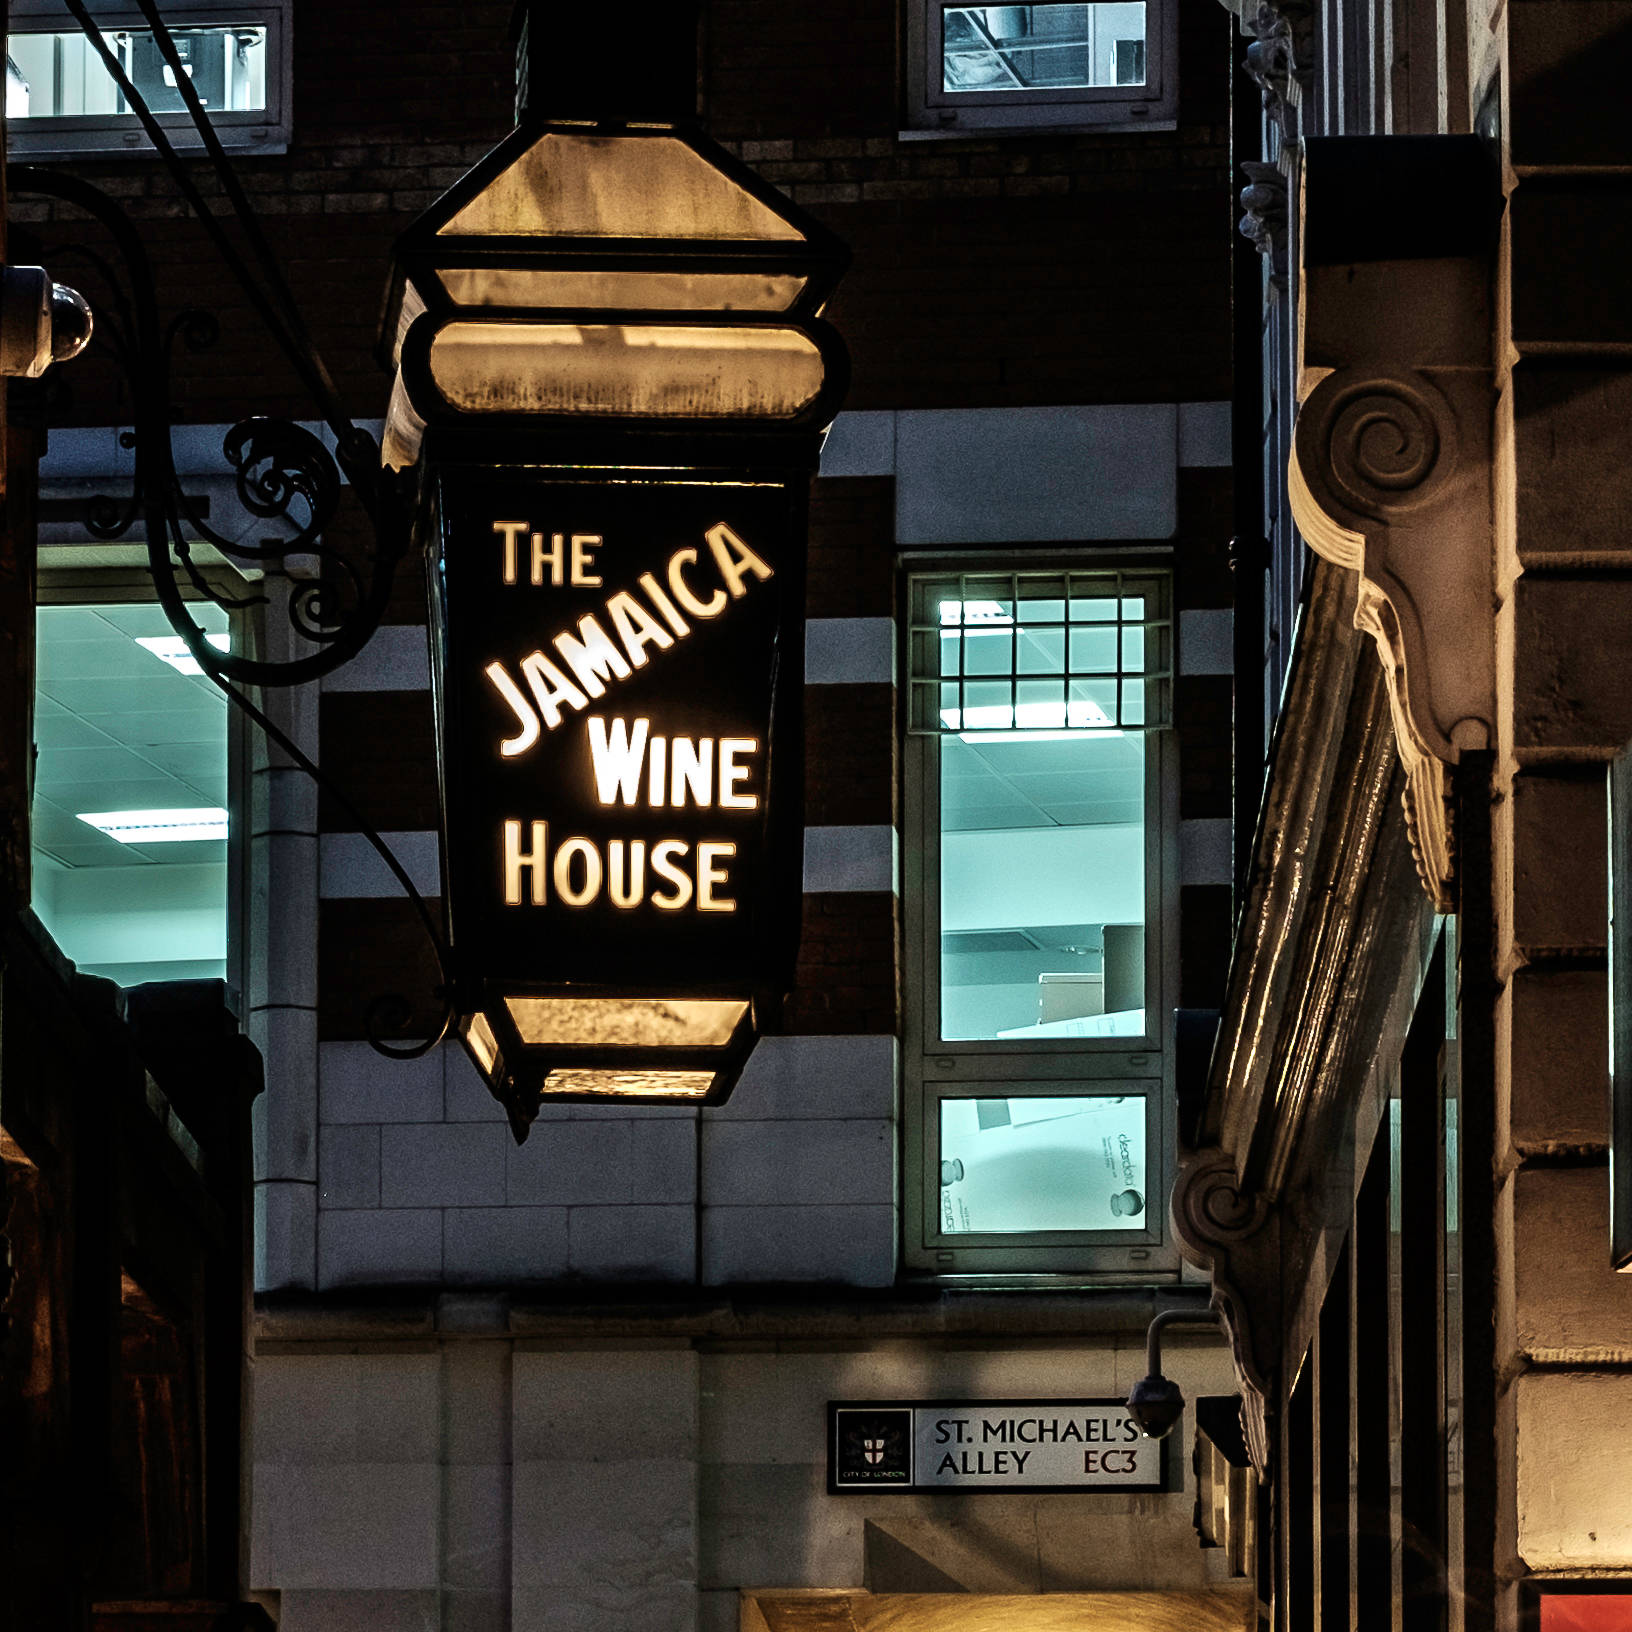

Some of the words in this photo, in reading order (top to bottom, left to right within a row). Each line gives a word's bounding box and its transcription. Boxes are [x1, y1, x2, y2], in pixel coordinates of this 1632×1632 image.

[492, 520, 604, 588] THE
[484, 521, 775, 758] JAMAICA
[587, 715, 759, 810] WINE
[503, 819, 738, 913] HOUSE
[935, 1419, 973, 1444] ST.
[982, 1418, 1139, 1444] MICHAEL'S
[936, 1450, 1032, 1476] ALLEY
[1083, 1450, 1138, 1474] EC3
